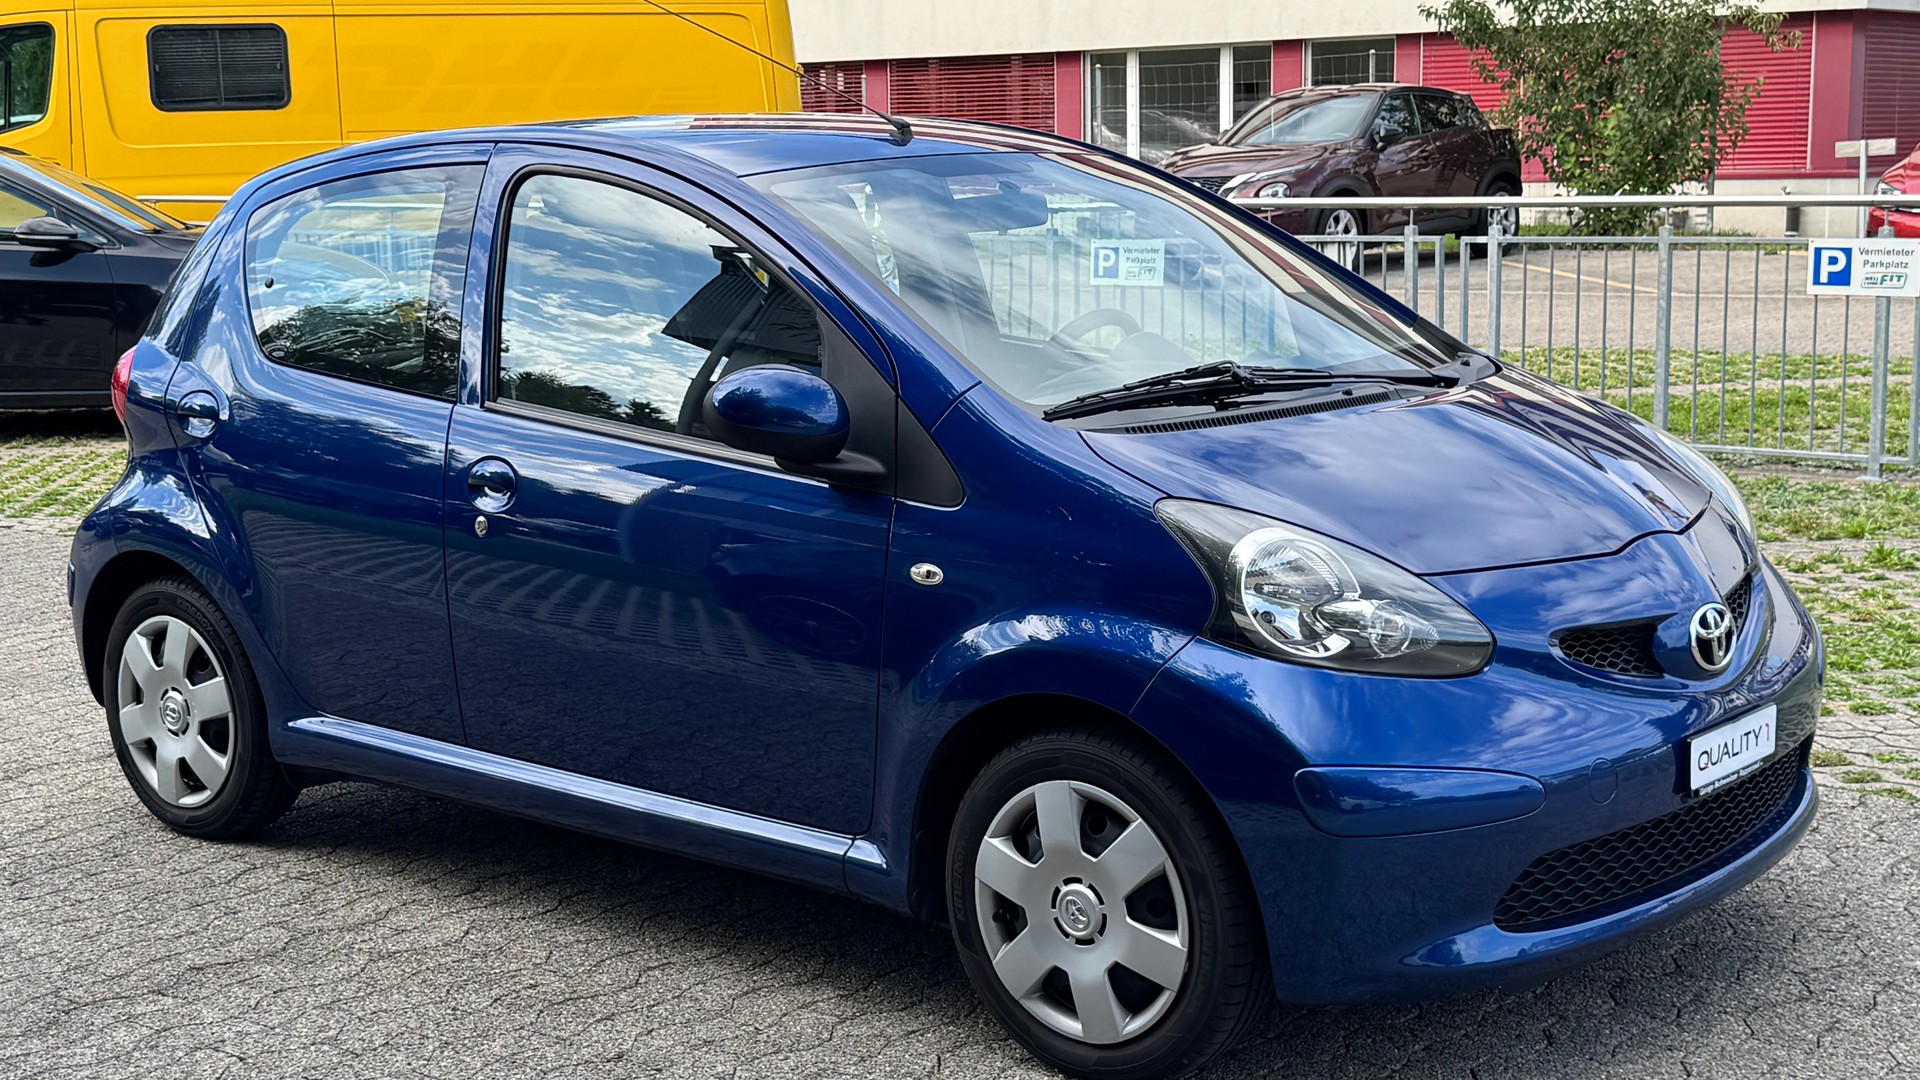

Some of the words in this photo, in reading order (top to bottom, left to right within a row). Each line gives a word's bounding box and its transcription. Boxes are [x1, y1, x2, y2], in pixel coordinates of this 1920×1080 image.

[1858, 247, 1915, 256] Vermieteter
[1097, 248, 1116, 276] P
[1819, 249, 1847, 283] P
[1863, 259, 1909, 270] Parkplatz
[1879, 274, 1904, 285] FIT
